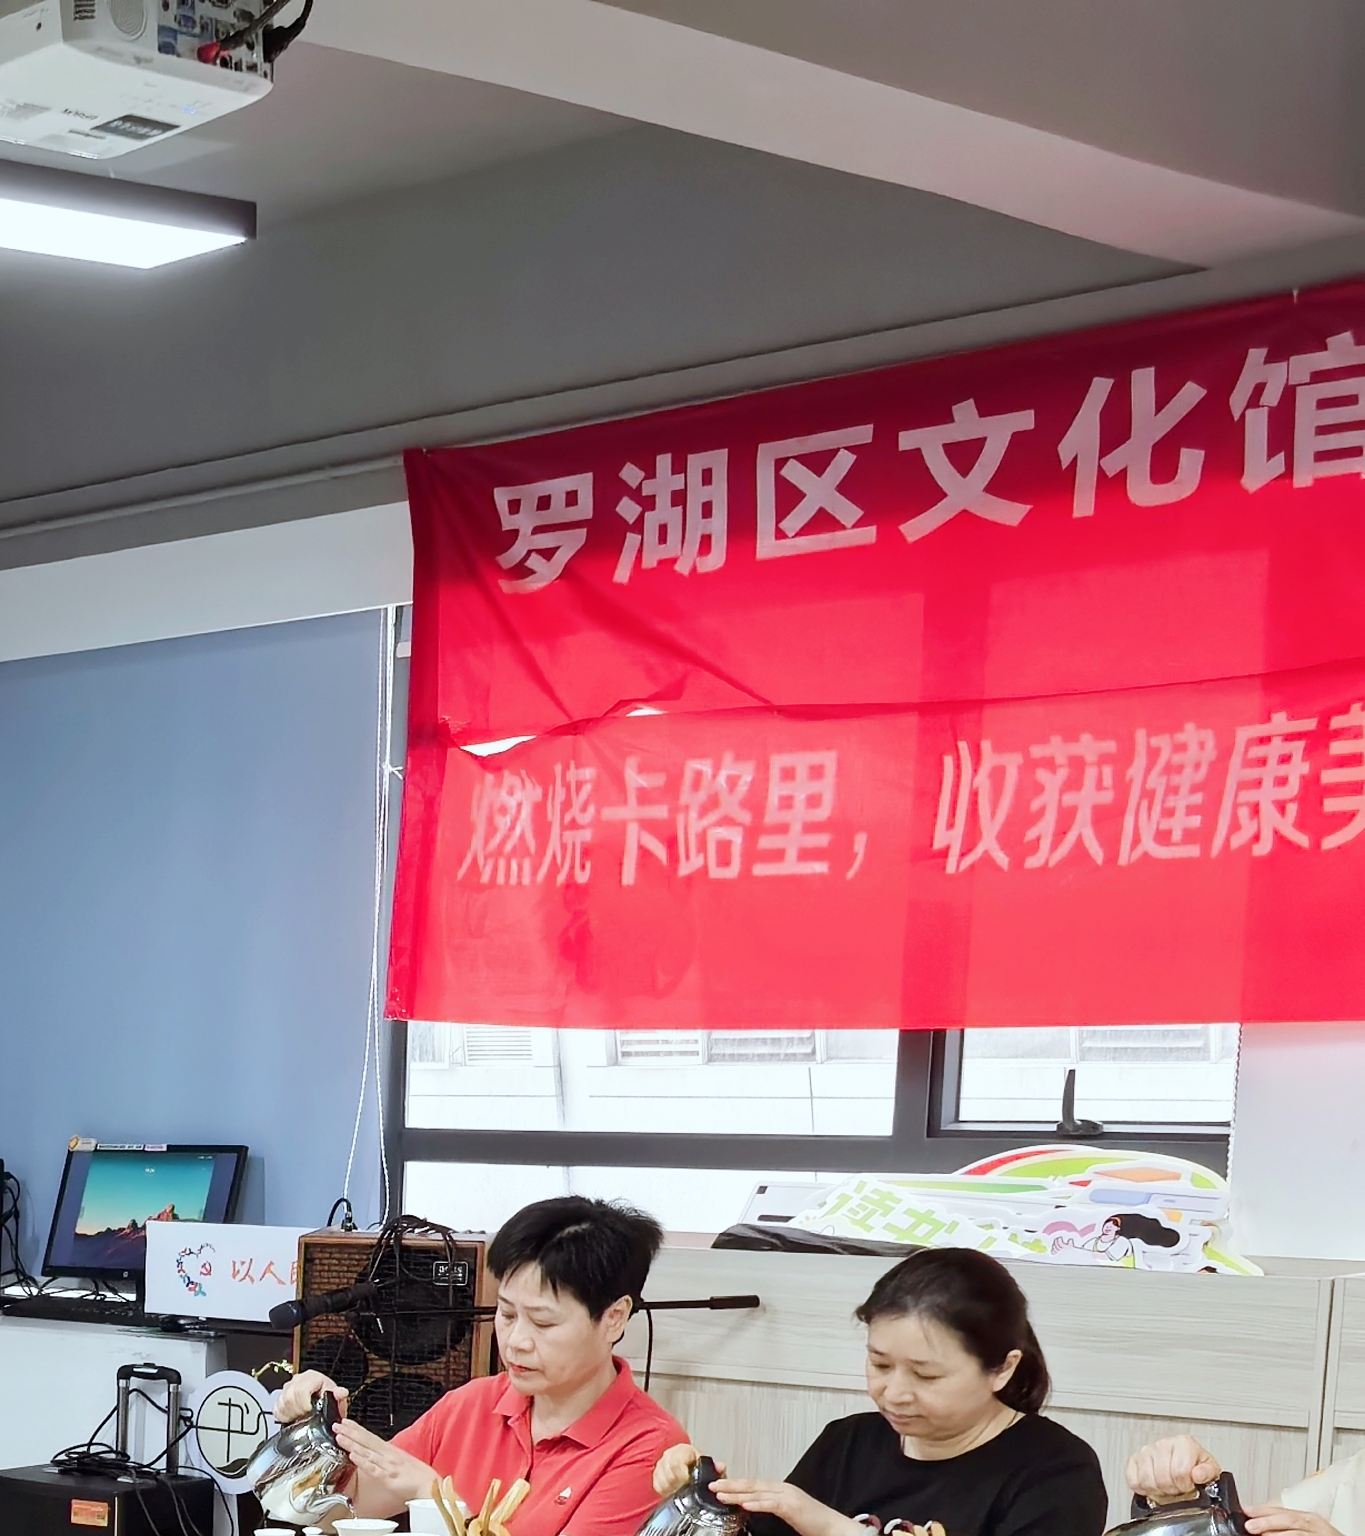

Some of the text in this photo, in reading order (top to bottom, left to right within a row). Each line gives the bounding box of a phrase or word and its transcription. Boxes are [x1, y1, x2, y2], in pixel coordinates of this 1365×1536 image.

[492, 331, 1365, 594] 罗湖区文化馆
